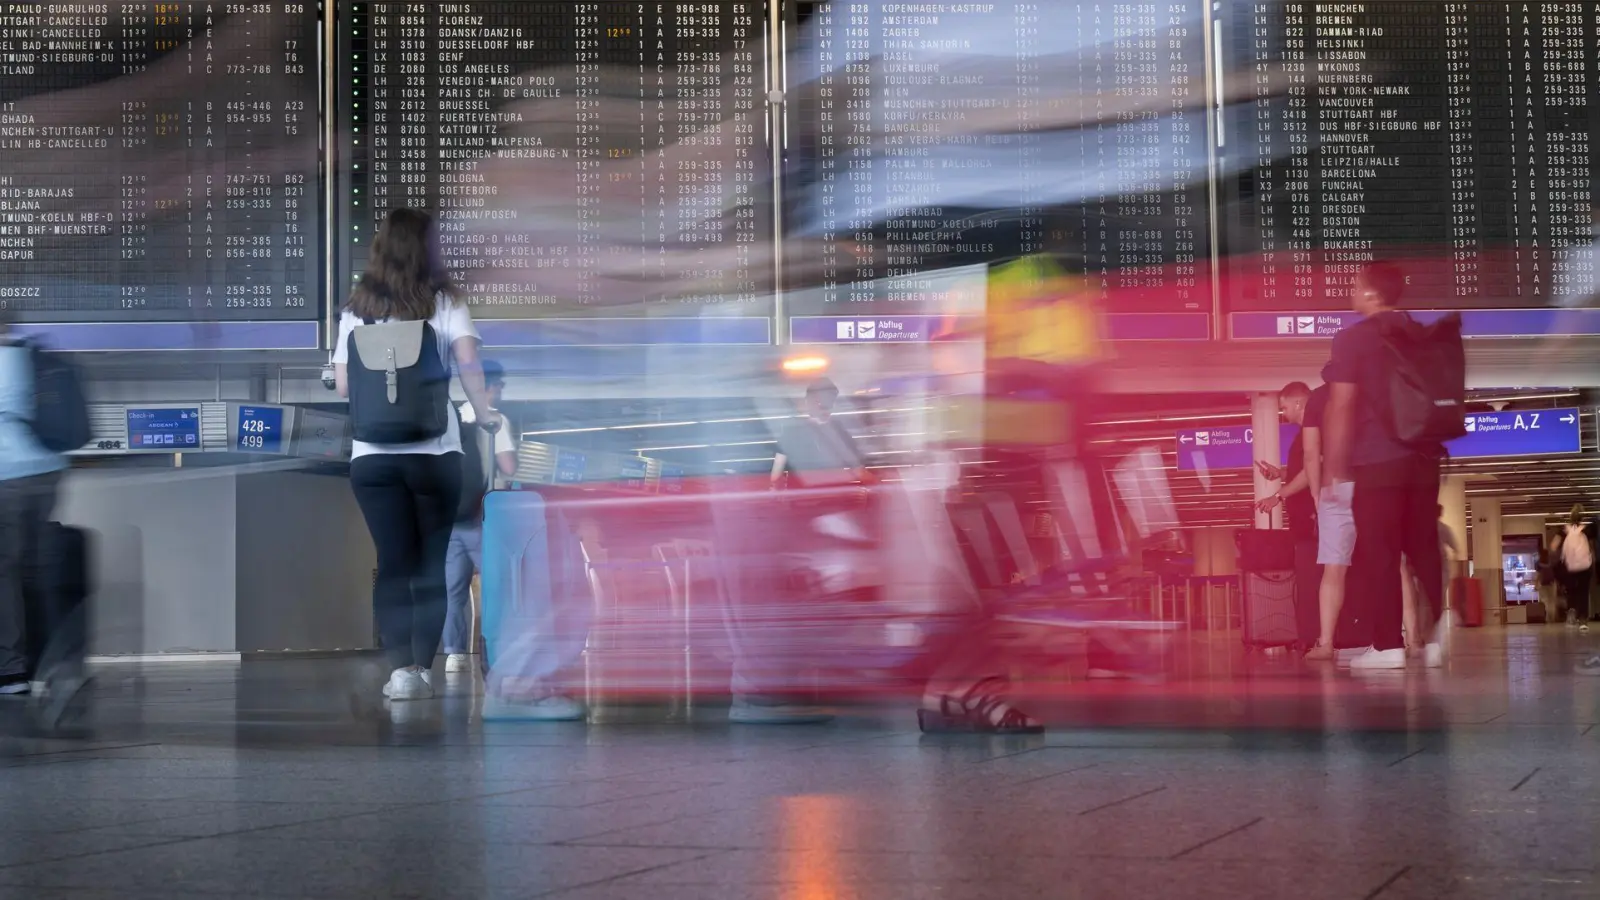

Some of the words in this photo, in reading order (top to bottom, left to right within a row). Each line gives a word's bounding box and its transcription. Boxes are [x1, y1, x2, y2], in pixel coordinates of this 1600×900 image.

[9, 4, 108, 14] PAULO-GUARULHOS
[226, 4, 271, 14] 259-335
[285, 4, 304, 14] B26
[406, 4, 425, 13] 745
[439, 4, 470, 13] TUNIS
[676, 4, 720, 13] 986-988
[733, 4, 745, 13] E5
[851, 4, 868, 13] 828
[882, 4, 994, 13] KOPENHAGEN-KASTRUP
[1169, 4, 1187, 13] A54
[1286, 4, 1303, 13] 106
[1315, 4, 1365, 13] MUENCHEN
[1541, 4, 1583, 13] 259-335
[400, 16, 425, 25] 8854
[439, 16, 483, 25] FLORENZ
[676, 17, 720, 25] 259-335
[733, 17, 752, 25] A25
[882, 16, 939, 25] AMSTERDAM
[1316, 16, 1352, 25] BREMEN
[0, 29, 101, 38] SINKI-CANCELLED
[401, 28, 425, 37] 1378
[439, 28, 522, 37] GDANSK/DANZIG
[882, 29, 920, 37] ZAGREB
[1316, 28, 1383, 37] DAMMAM-RIAD
[22, 41, 114, 50] BAD-MANNHEIM-K
[285, 41, 297, 50] T7
[400, 40, 425, 49] 3510
[439, 40, 509, 49] DUESSELDORF
[516, 40, 534, 49] HBF
[1317, 40, 1364, 48] HELSINKI
[285, 53, 297, 62] T6
[401, 52, 425, 61] 1083
[439, 52, 464, 61] GENF
[1318, 51, 1366, 60] LISSABON
[227, 65, 271, 74] 773-786
[285, 65, 304, 74] B43
[400, 65, 425, 74] 2080
[439, 65, 458, 74] LOS
[464, 65, 509, 73] ANGELES
[677, 65, 721, 73] 773-786
[734, 65, 752, 73] B48
[845, 64, 870, 73] 8752
[884, 64, 939, 73] LUXEMBURG
[1282, 63, 1305, 72] 1230
[1318, 63, 1360, 72] MYKONOS
[1543, 62, 1585, 71] 656-688
[439, 76, 523, 85] VENEDIG-MARCO
[529, 76, 555, 85] POLO
[734, 77, 752, 85] A24
[1318, 75, 1373, 84] NUERNBERG
[439, 89, 471, 98] PARIS
[478, 89, 496, 97] CH.
[503, 88, 515, 97] DE
[523, 88, 561, 97] GAULLE
[852, 88, 870, 97] 208
[1318, 87, 1337, 95] NEW
[1343, 87, 1410, 95] YORK-NEWARK
[226, 101, 271, 110] 445-446
[285, 101, 304, 110] A23
[400, 101, 425, 110] 2612
[439, 101, 490, 110] BRUESSEL
[1319, 98, 1374, 107] VANCOUVER
[0, 114, 35, 124] GHADA
[226, 114, 271, 123] 954-955
[285, 114, 297, 123] E4
[439, 113, 523, 122] FUERTEVENTURA
[678, 113, 721, 121] 759-770
[847, 112, 871, 121] 1580
[1319, 110, 1373, 119] STUTTGART
[1380, 110, 1398, 119] HBF
[439, 125, 497, 134] KATTOWITZ
[884, 124, 940, 133] BANGALORE
[1320, 122, 1338, 131] DUS
[1344, 122, 1417, 131] HBF-SIEGBURG
[1424, 122, 1441, 130] HBF
[439, 137, 542, 146] MAILAND-MALPENSA
[735, 137, 753, 145] B13
[847, 136, 871, 145] 2062
[1320, 134, 1369, 142] HANNOVER
[28, 139, 107, 148] HB-CANCELLED
[439, 150, 569, 159] MUENCHEN-WUERZBURG-N
[1321, 146, 1375, 155] STUTTGART
[439, 162, 478, 171] TRIEST
[1321, 158, 1400, 167] LEIPZIG/HALLE
[439, 174, 485, 183] BOLOGNA
[1321, 170, 1376, 178] BARCELONA
[226, 175, 271, 184] 747-751
[285, 175, 304, 184] B62
[1260, 182, 1272, 190] X3
[1285, 182, 1309, 190] 2806
[1322, 182, 1364, 190] FUNCHAL
[1548, 180, 1590, 189] 956-957
[226, 187, 271, 196] 908-910
[285, 187, 304, 196] D21
[439, 186, 498, 195] GOETEBORG
[1322, 193, 1365, 202] CALGARY
[226, 200, 271, 209] 259-335
[285, 200, 297, 208] B6
[439, 198, 485, 207] BILLUND
[886, 208, 943, 217] HYDERABAD
[1174, 207, 1193, 215] B22
[1322, 205, 1365, 214] DRESDEN
[80, 213, 113, 222] HBF-D
[439, 210, 517, 219] POZNAN/POSEN
[848, 220, 873, 229] 3612
[1323, 217, 1360, 226] BOSTON
[27, 225, 112, 235] BHF-MUENSTER-
[1323, 229, 1360, 238] DENVER
[886, 232, 962, 240] PHILADELPHIA
[1175, 230, 1193, 239] C15
[285, 236, 304, 245] A11
[887, 244, 993, 253] WASHINGTON-DULLES
[1120, 242, 1162, 251] 259-335
[1176, 242, 1193, 251] Z66
[1324, 241, 1372, 250] BUKAREST
[226, 248, 271, 258] 656-688
[285, 248, 304, 257] B46
[1293, 253, 1311, 262] 571
[1324, 253, 1373, 261] LISSABON
[887, 256, 923, 265] MUMBAI
[888, 281, 931, 290] ZUERICH
[850, 293, 875, 302] 3652
[888, 293, 926, 302] BREMEN
[226, 298, 272, 307] 259-335
[285, 298, 305, 307] A30
[1317, 316, 1341, 325] Abflug
[878, 321, 903, 330] Abflug
[878, 331, 919, 340] Departures
[1478, 416, 1499, 424] Abflug
[242, 420, 271, 432] 428-
[1478, 424, 1511, 432] Departures
[97, 441, 121, 449] 464
[242, 435, 263, 448] 499
